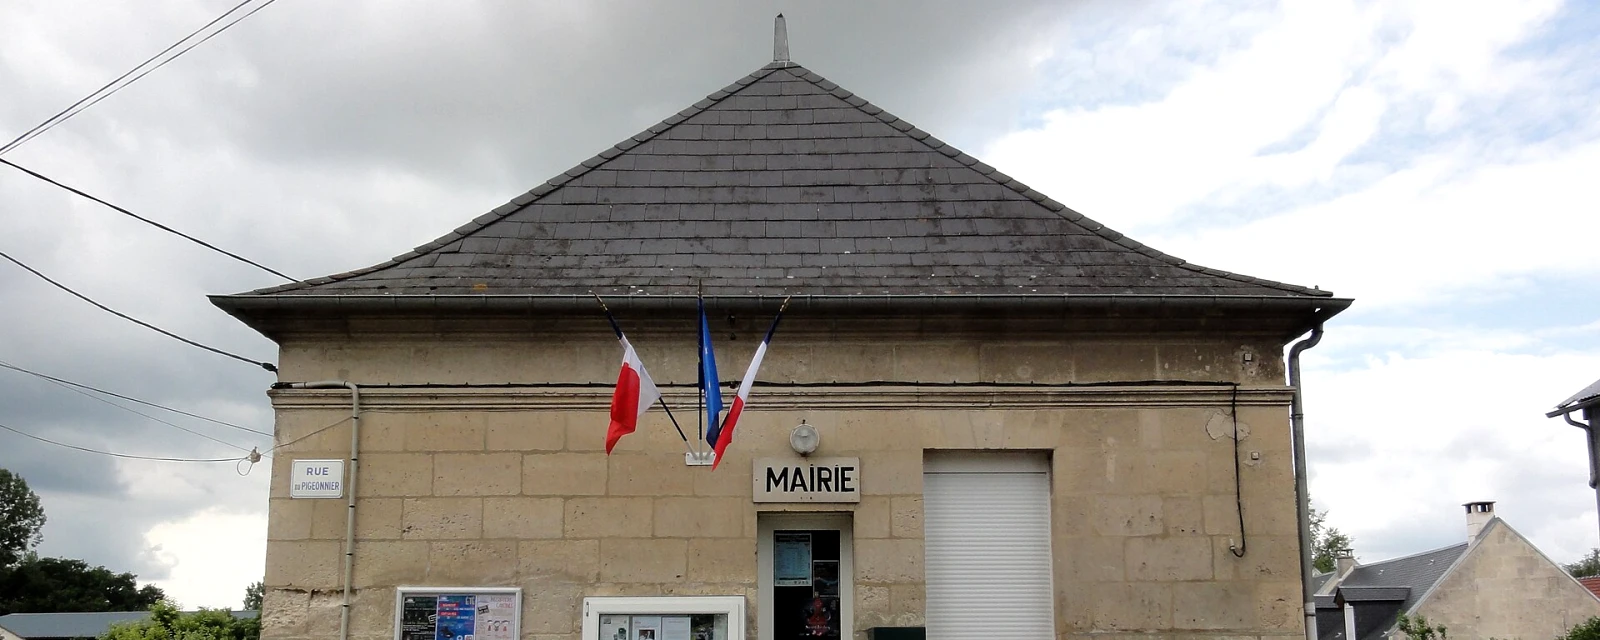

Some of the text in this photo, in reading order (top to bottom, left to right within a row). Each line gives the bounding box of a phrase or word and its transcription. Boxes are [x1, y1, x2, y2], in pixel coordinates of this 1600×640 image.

[306, 467, 329, 475] RUE
[766, 464, 855, 492] MAIRIE
[301, 481, 339, 490] PIGEONNIER
